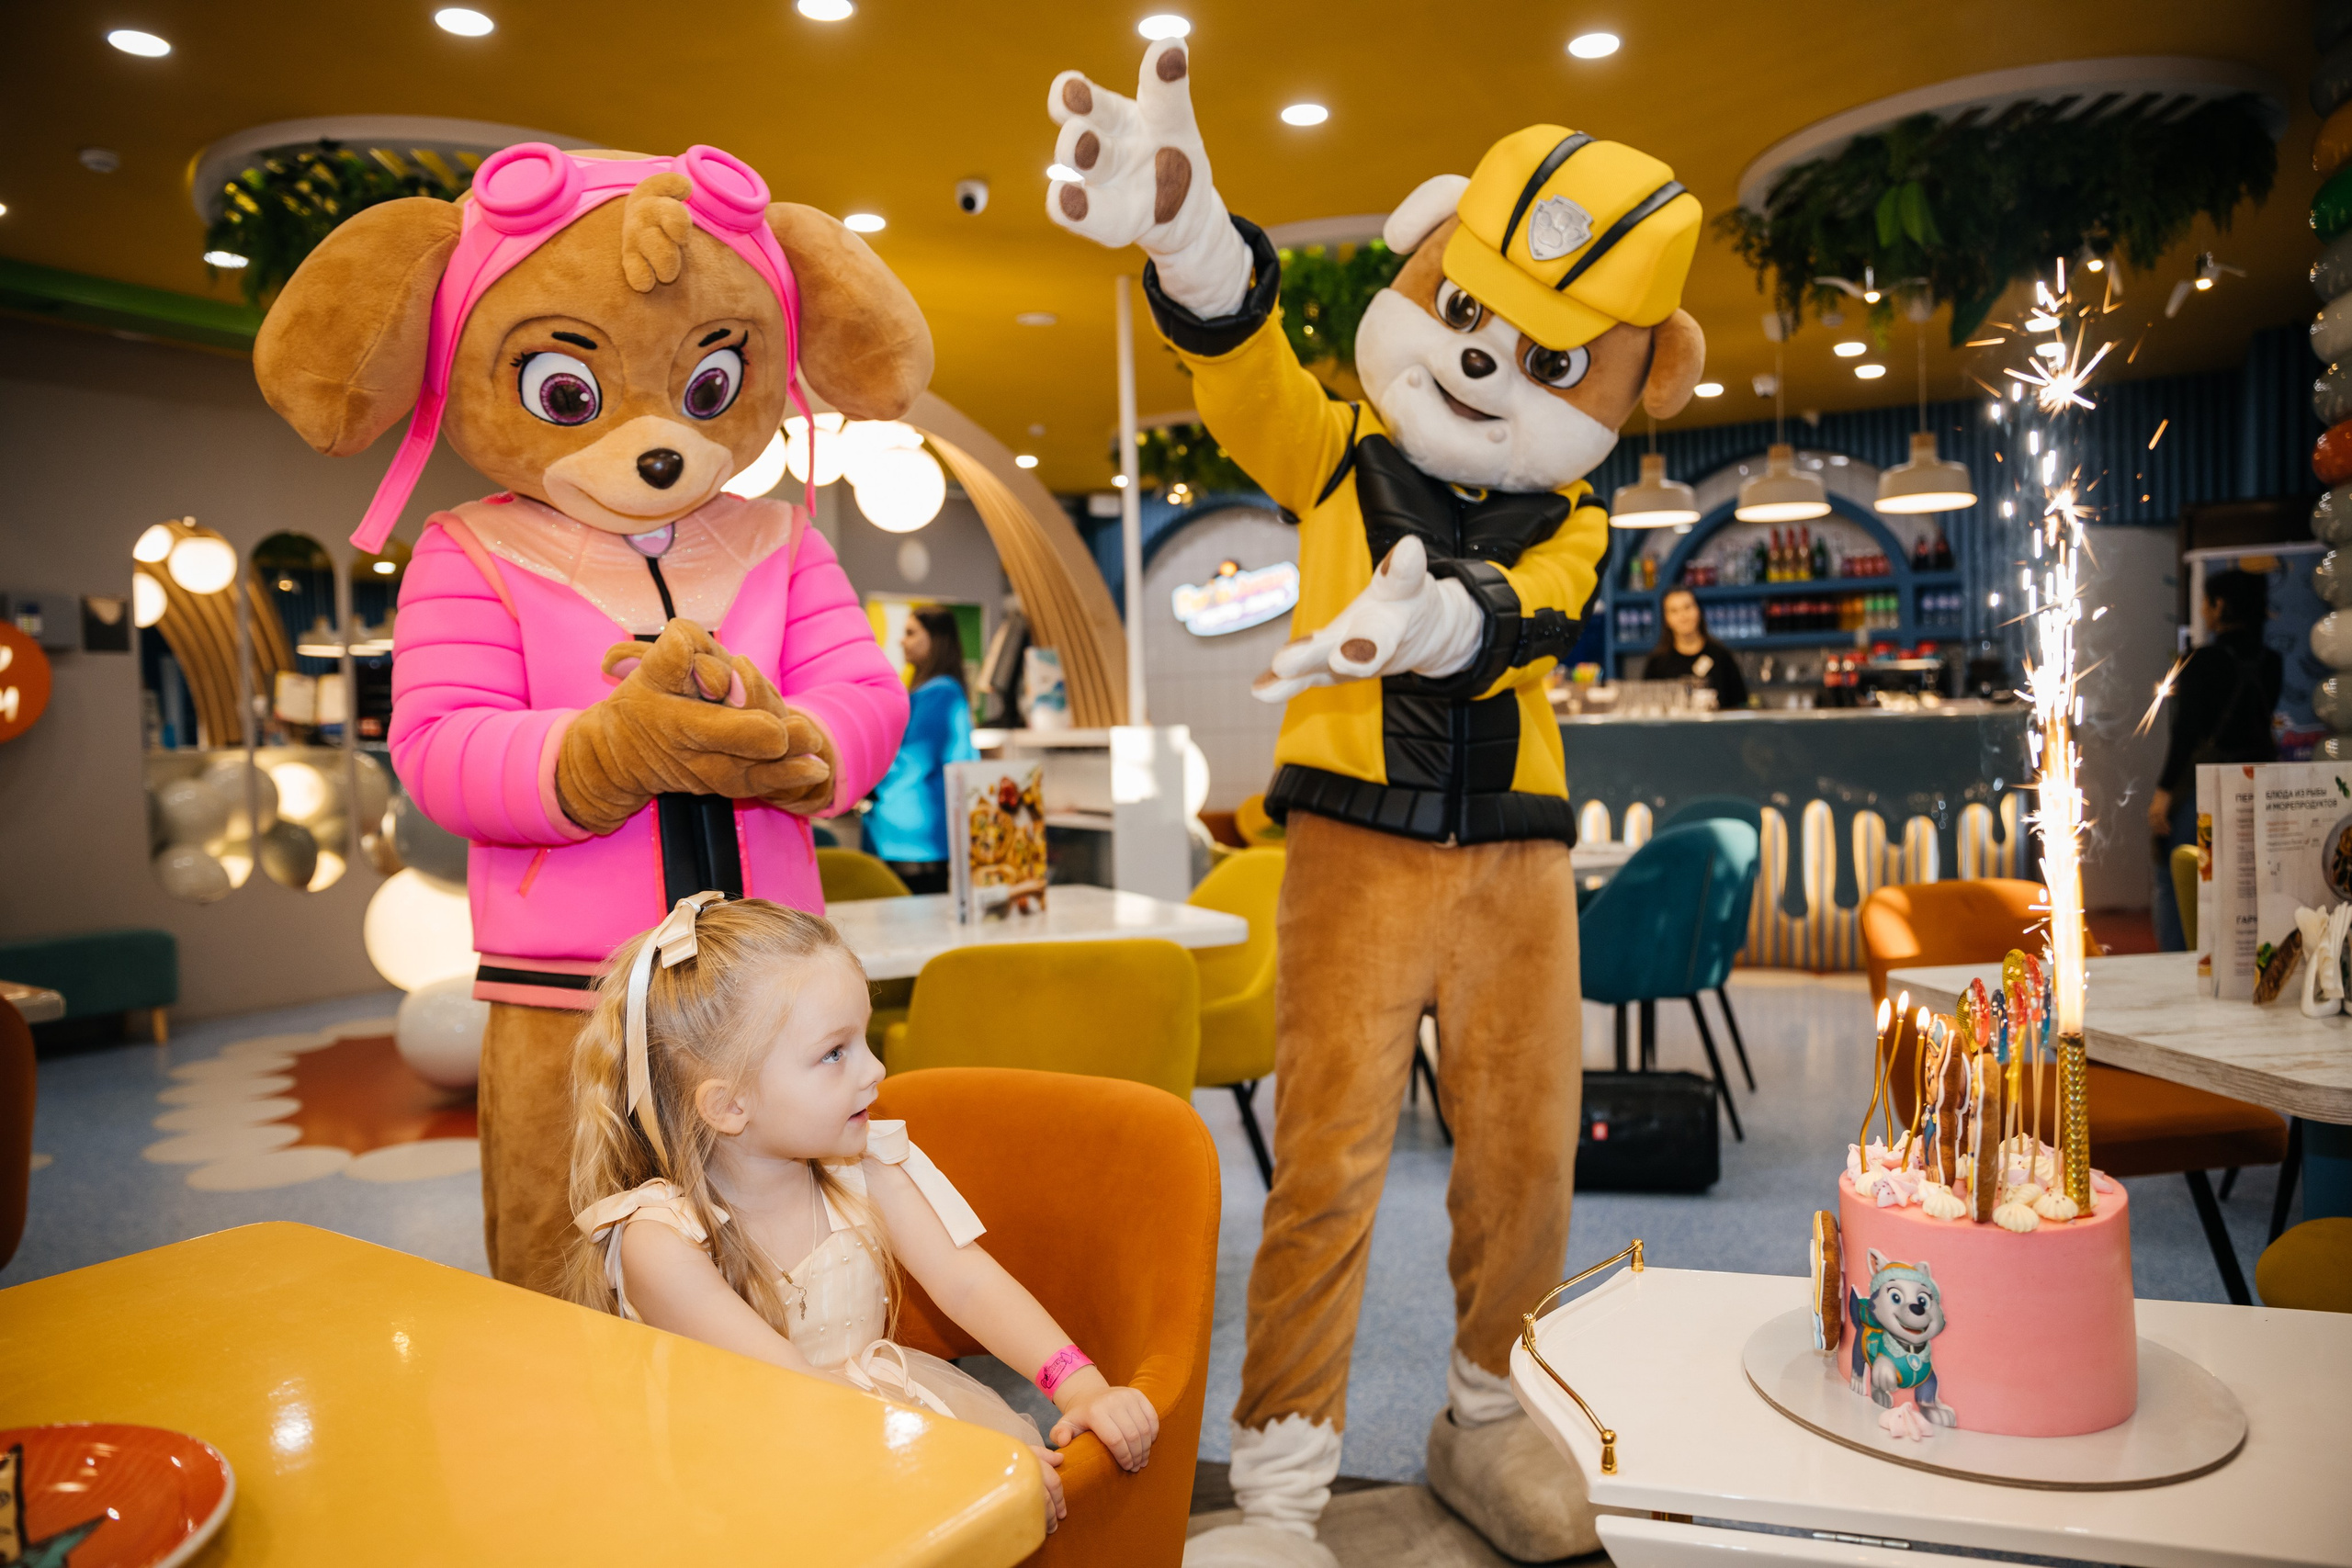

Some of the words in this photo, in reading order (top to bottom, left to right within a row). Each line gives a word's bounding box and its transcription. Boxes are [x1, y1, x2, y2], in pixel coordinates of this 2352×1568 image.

[2266, 789, 2293, 800] БЛЮДА
[2295, 789, 2305, 798] ИЗ
[2306, 787, 2327, 797] РЫБЫ
[2266, 803, 2272, 812] И
[2273, 798, 2337, 811] МОРЕПРОДУКТОВ
